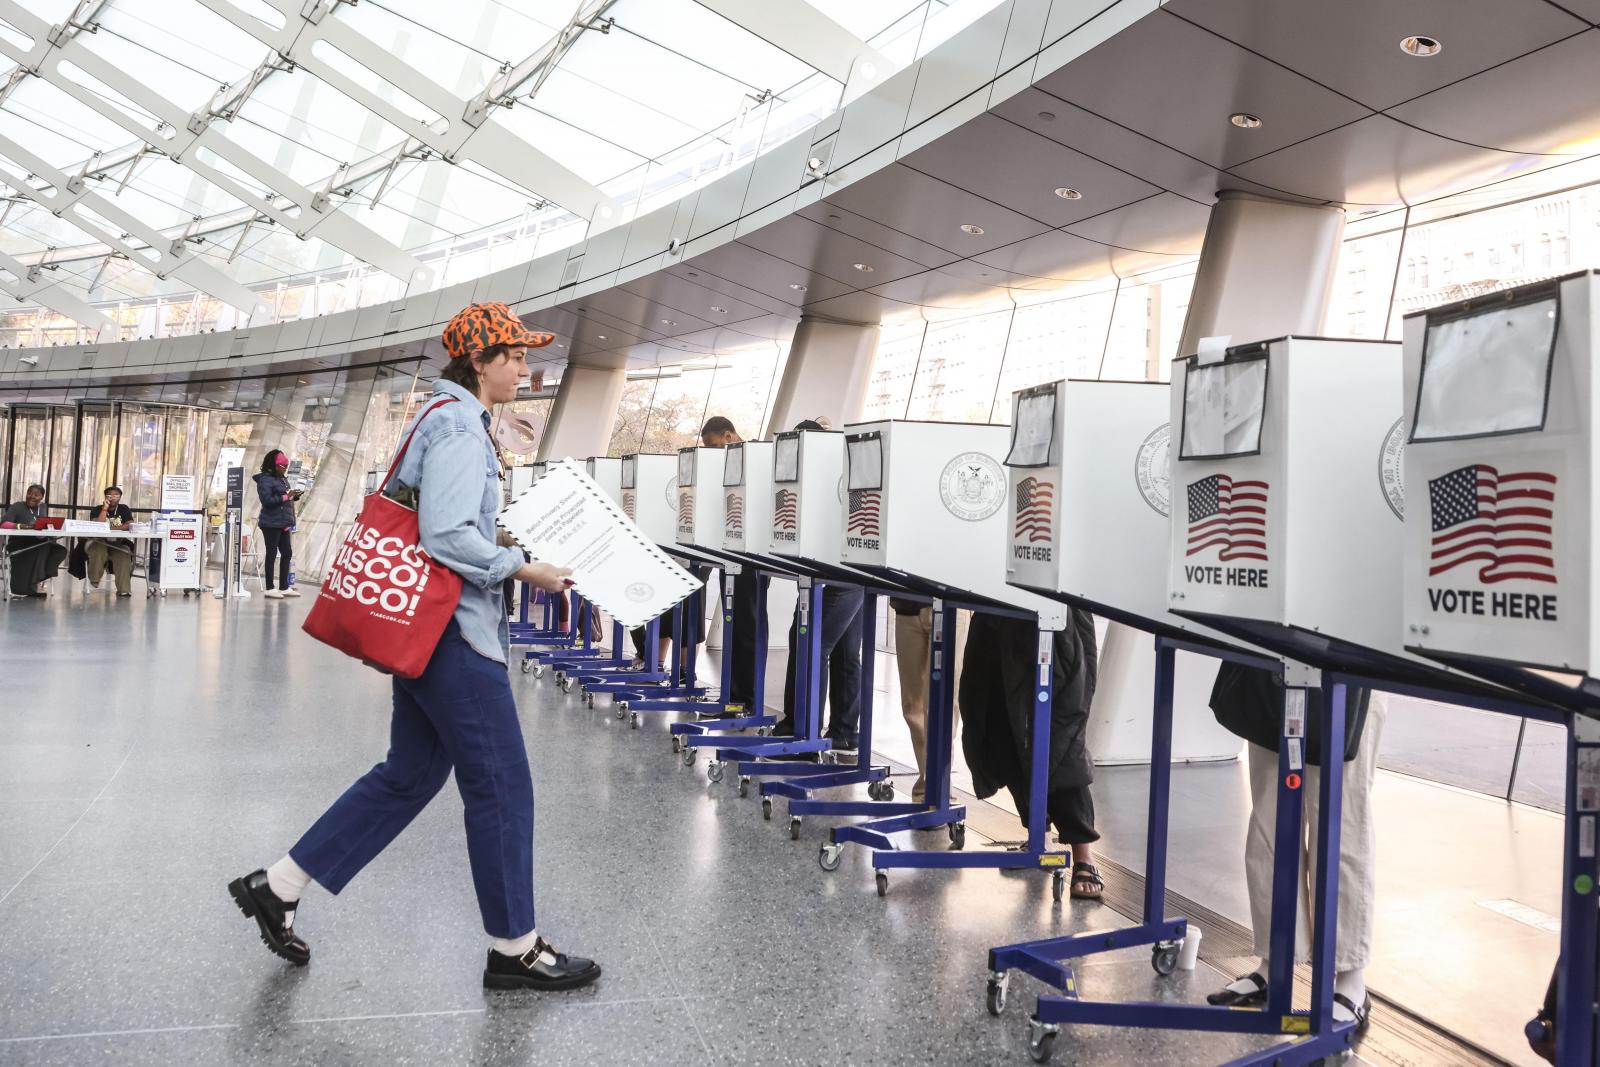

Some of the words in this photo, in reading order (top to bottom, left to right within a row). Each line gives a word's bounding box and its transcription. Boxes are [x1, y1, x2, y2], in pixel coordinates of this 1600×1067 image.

[773, 530, 785, 541] VOTE
[784, 531, 796, 541] HERE
[846, 536, 862, 548] VOTE
[863, 538, 880, 550] HERE
[1014, 545, 1031, 560] VOTE
[1032, 546, 1052, 562] HERE
[333, 545, 430, 592] IASCO!
[1185, 565, 1222, 584] VOTE
[1226, 567, 1268, 588] HERE
[1428, 588, 1485, 615] VOTE
[1491, 592, 1558, 621] HERE
